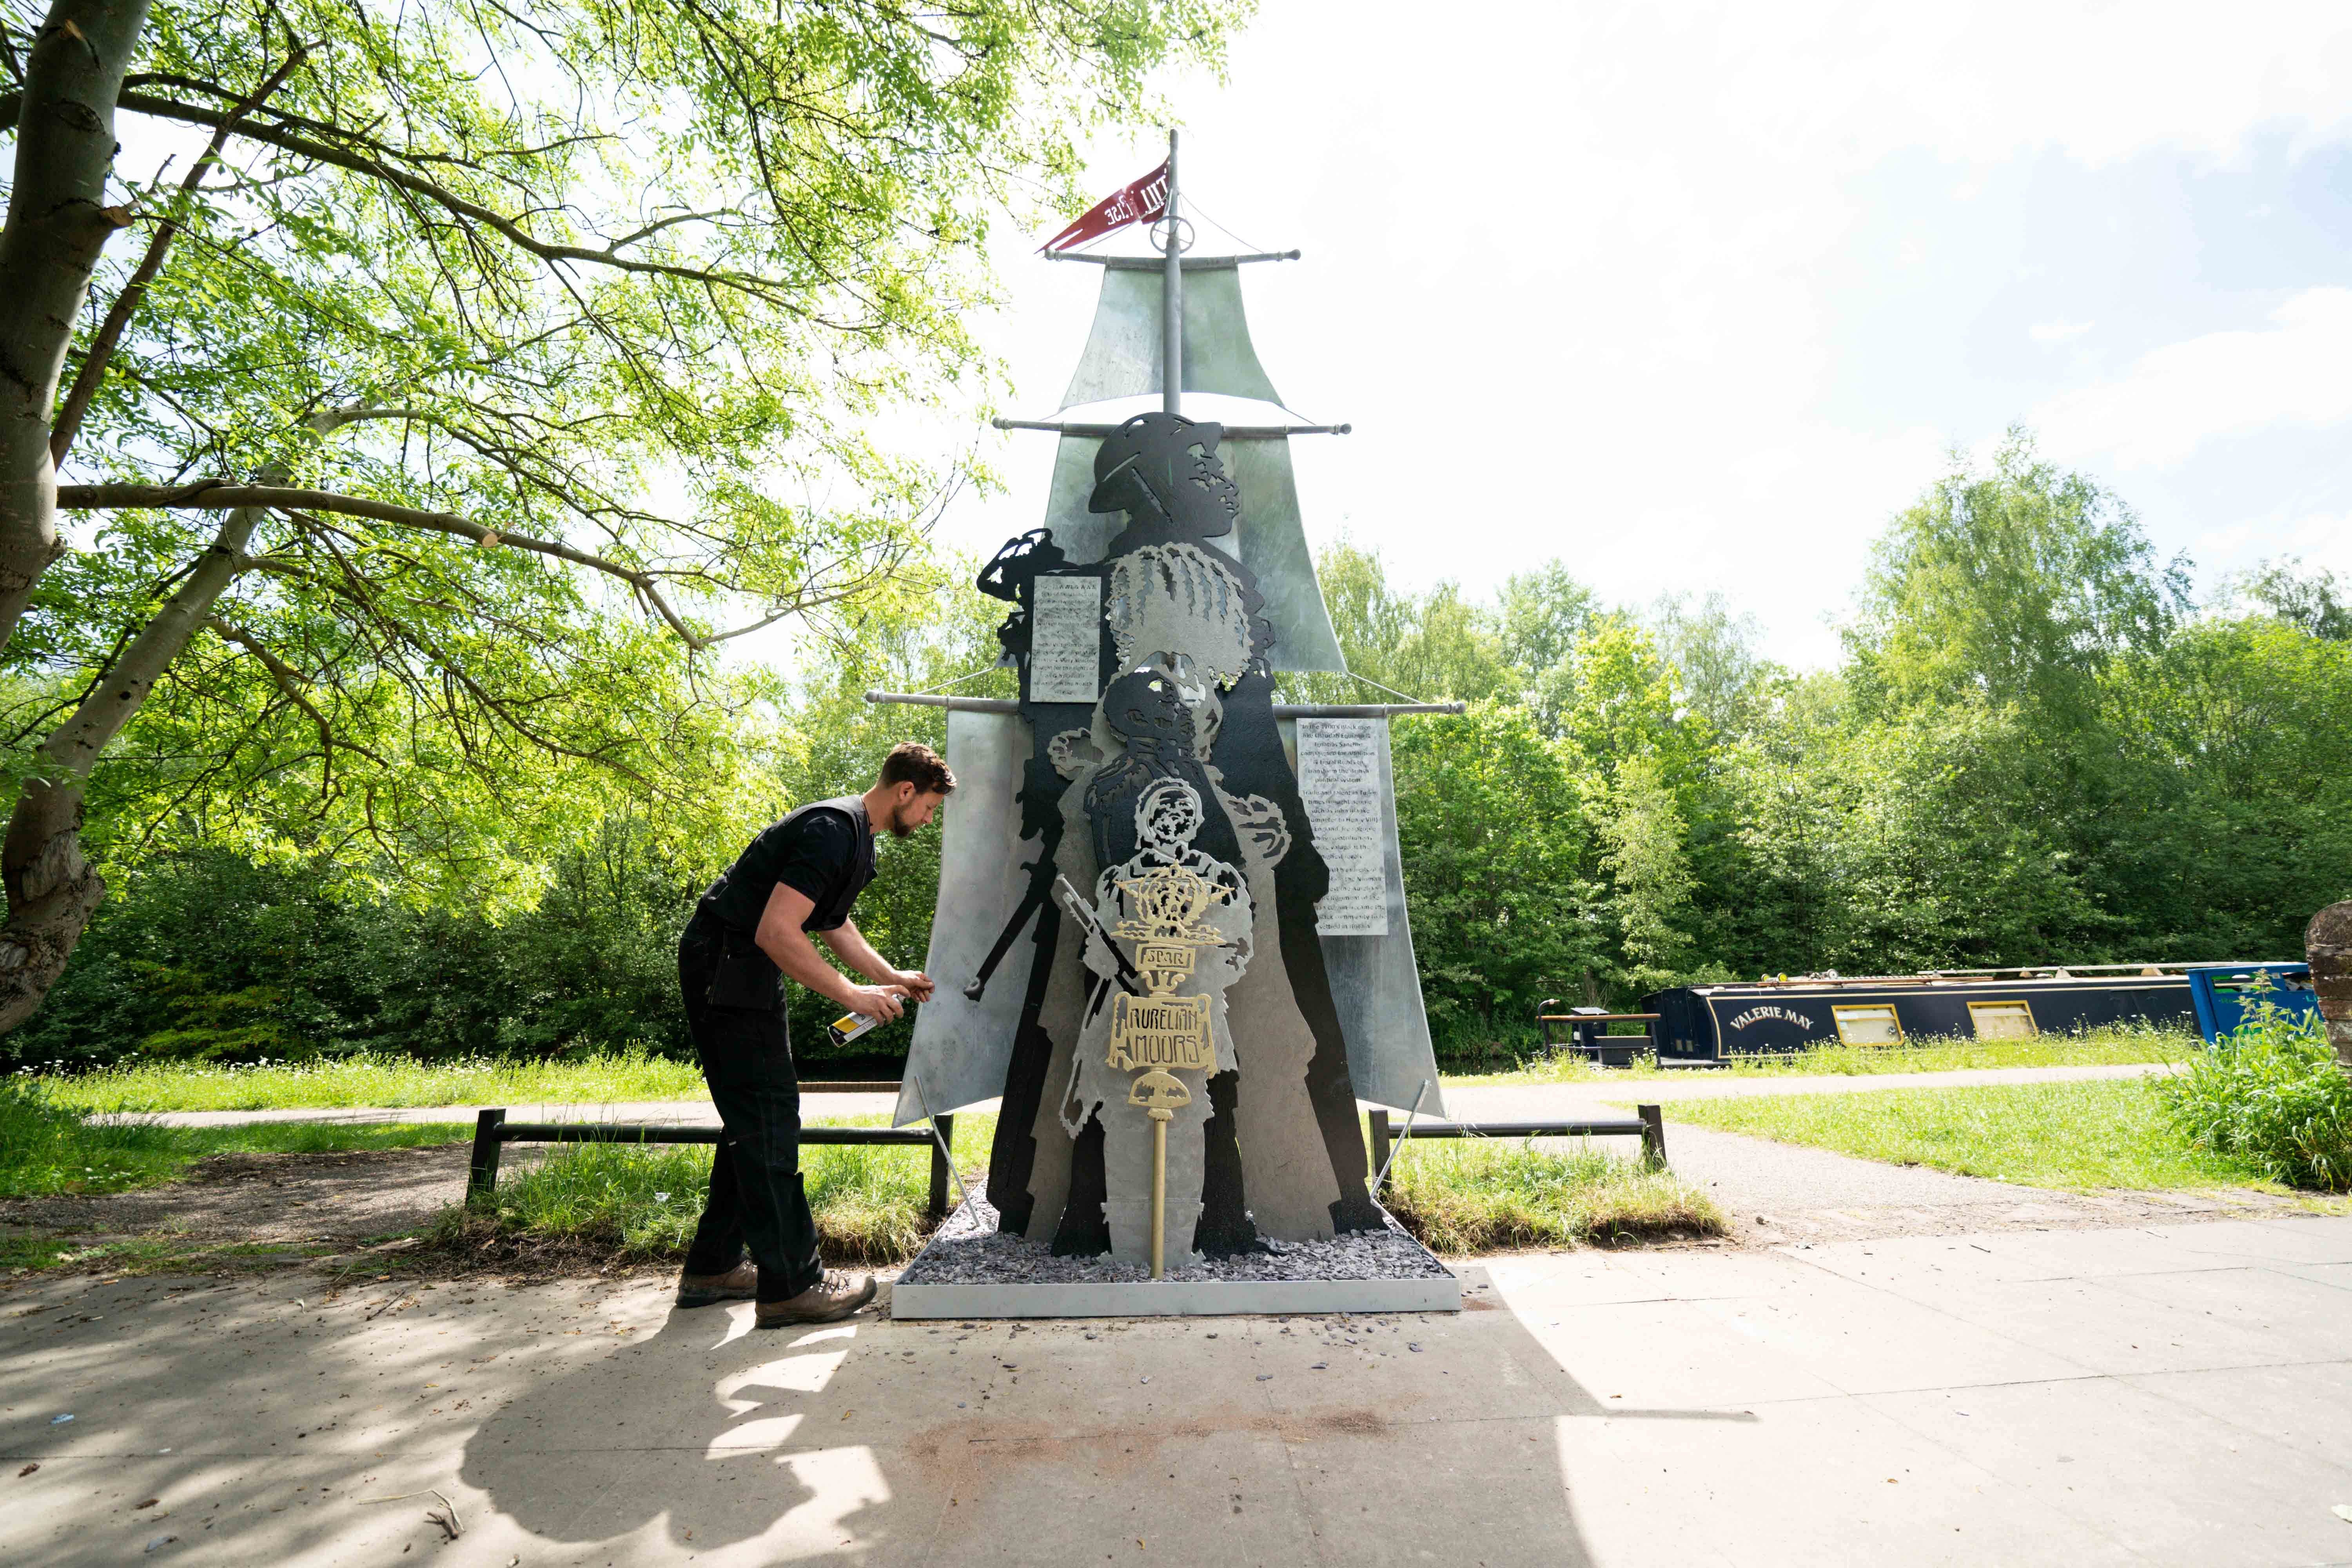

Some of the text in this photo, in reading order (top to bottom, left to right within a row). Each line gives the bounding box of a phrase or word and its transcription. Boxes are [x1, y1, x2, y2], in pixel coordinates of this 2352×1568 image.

[1130, 1009, 1198, 1031] AURELIAN
[1730, 1006, 1814, 1031] VALERIE MAY
[1135, 1035, 1200, 1064] MOORS
